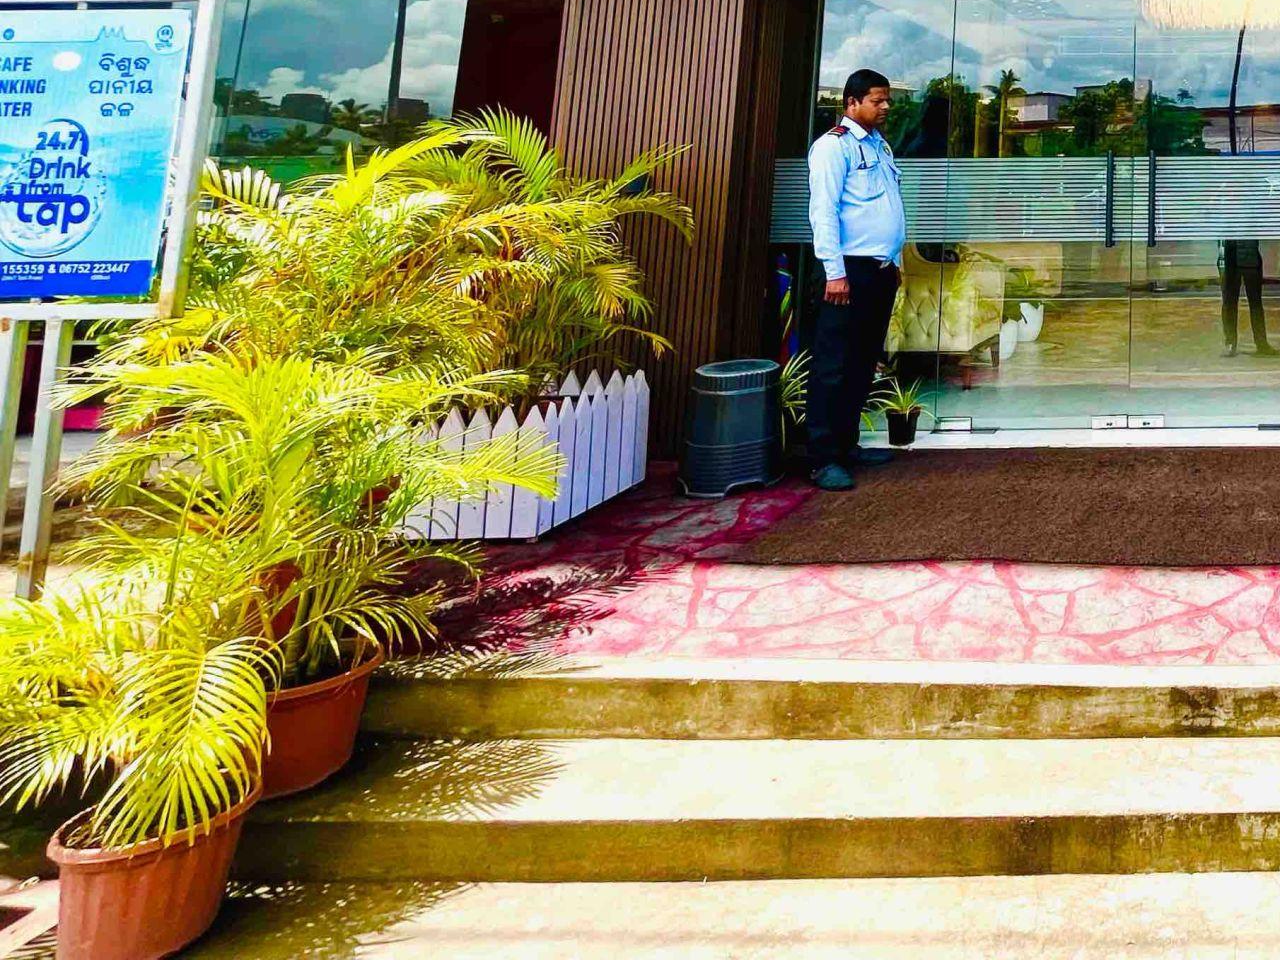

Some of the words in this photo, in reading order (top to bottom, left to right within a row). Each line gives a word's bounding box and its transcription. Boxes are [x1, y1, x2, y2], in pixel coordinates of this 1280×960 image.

[28, 156, 92, 179] Drink
[9, 189, 91, 234] tap
[47, 264, 56, 274] &
